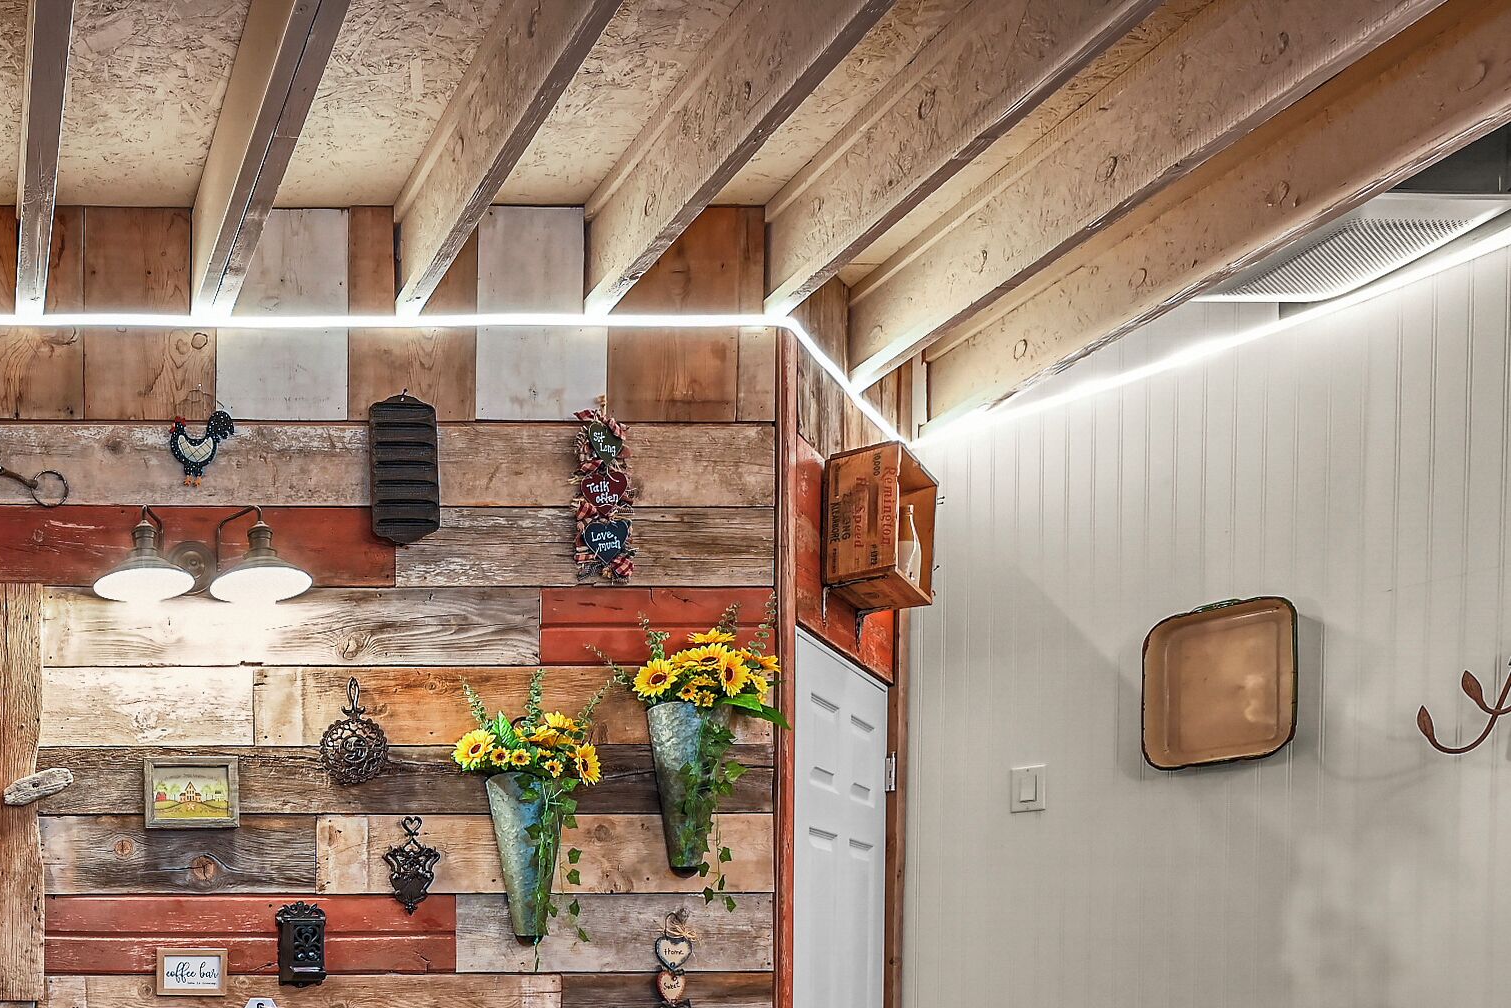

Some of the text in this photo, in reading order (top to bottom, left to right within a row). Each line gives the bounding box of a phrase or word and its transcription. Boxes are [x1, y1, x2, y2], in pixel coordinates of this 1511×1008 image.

[593, 431, 606, 443] Sit
[586, 481, 610, 494] Talk
[595, 493, 619, 504] often
[881, 466, 896, 546] Remington
[598, 535, 621, 552] much
[663, 947, 684, 956] Home
[166, 961, 219, 983] coffee bar
[663, 981, 681, 991] Sweet
